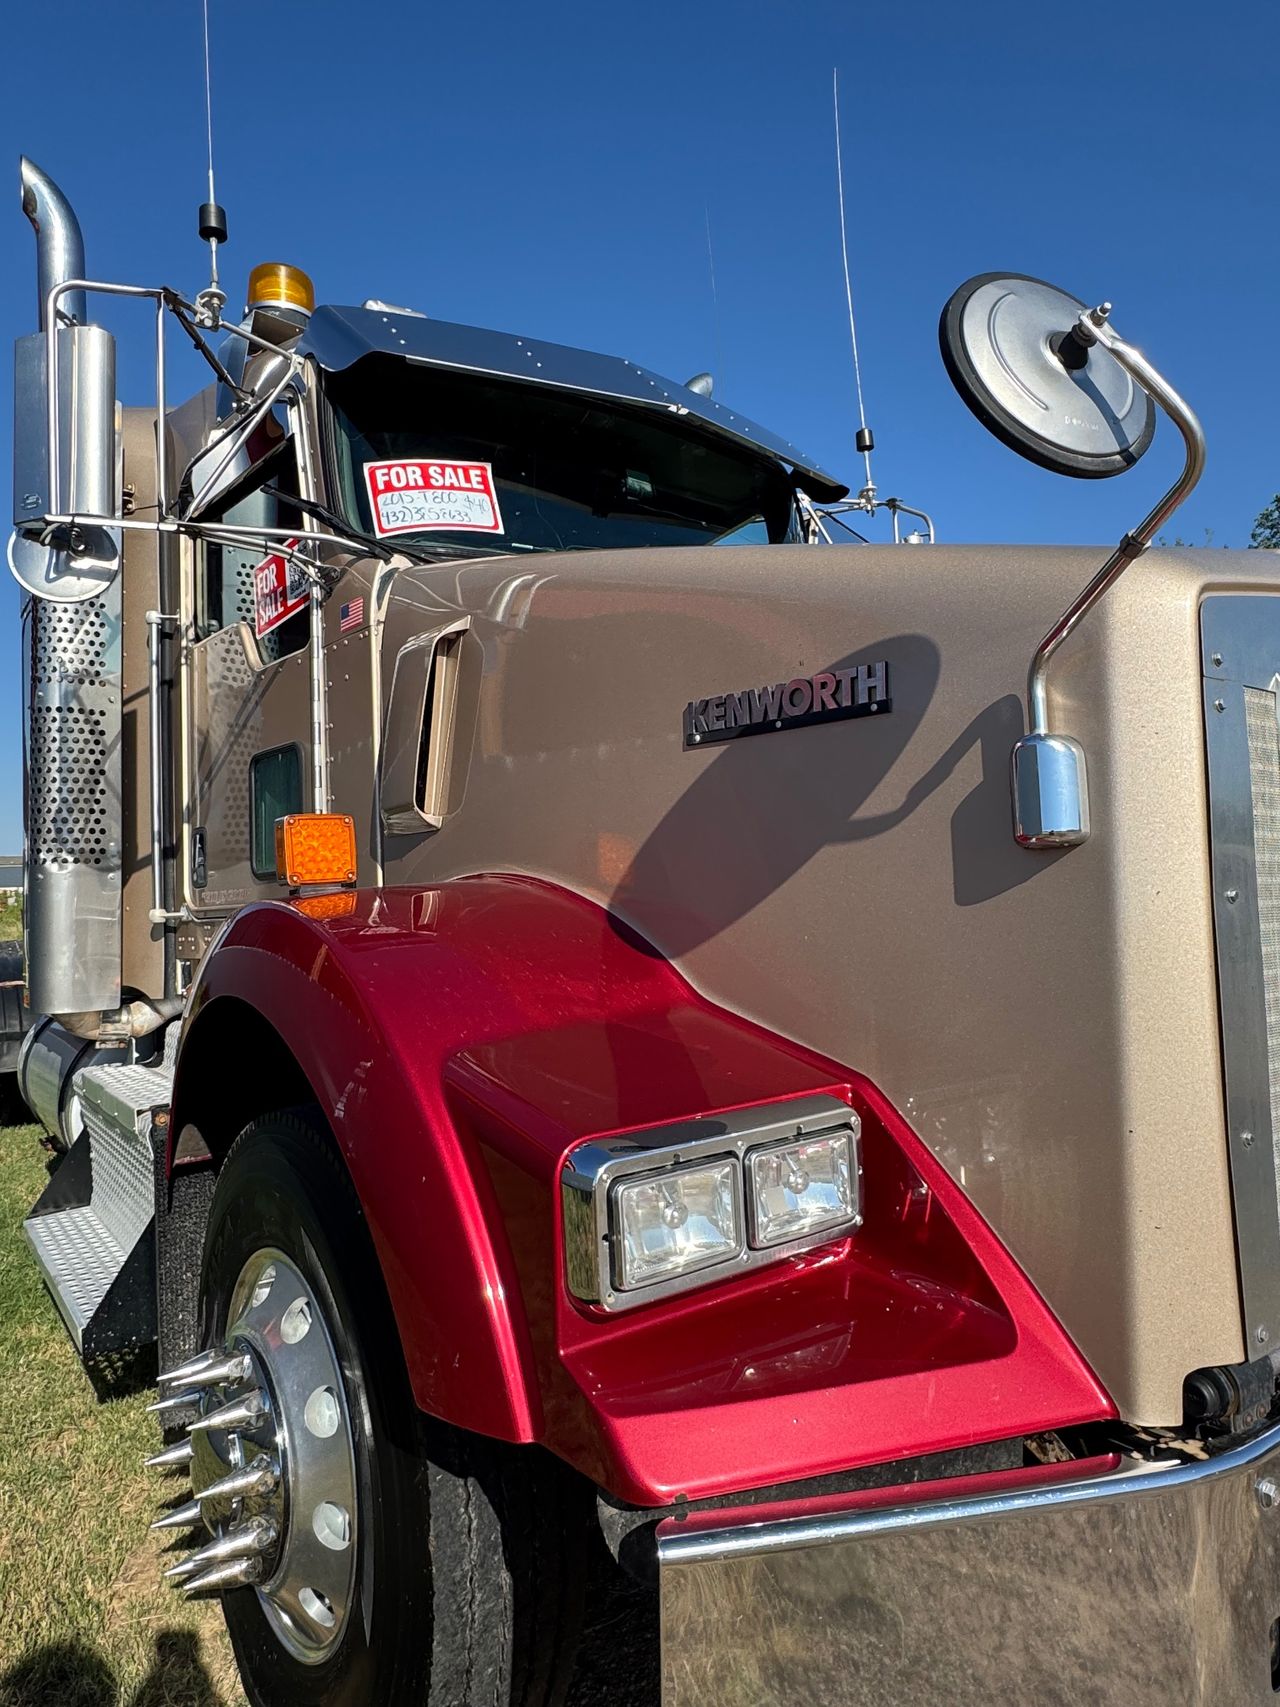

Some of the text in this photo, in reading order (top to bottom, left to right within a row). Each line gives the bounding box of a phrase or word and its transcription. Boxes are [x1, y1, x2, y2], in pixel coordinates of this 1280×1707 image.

[375, 466, 484, 490] FOR SALE
[257, 563, 278, 601] FOR
[259, 585, 284, 626] SALE
[686, 660, 889, 735] KENWORTH
